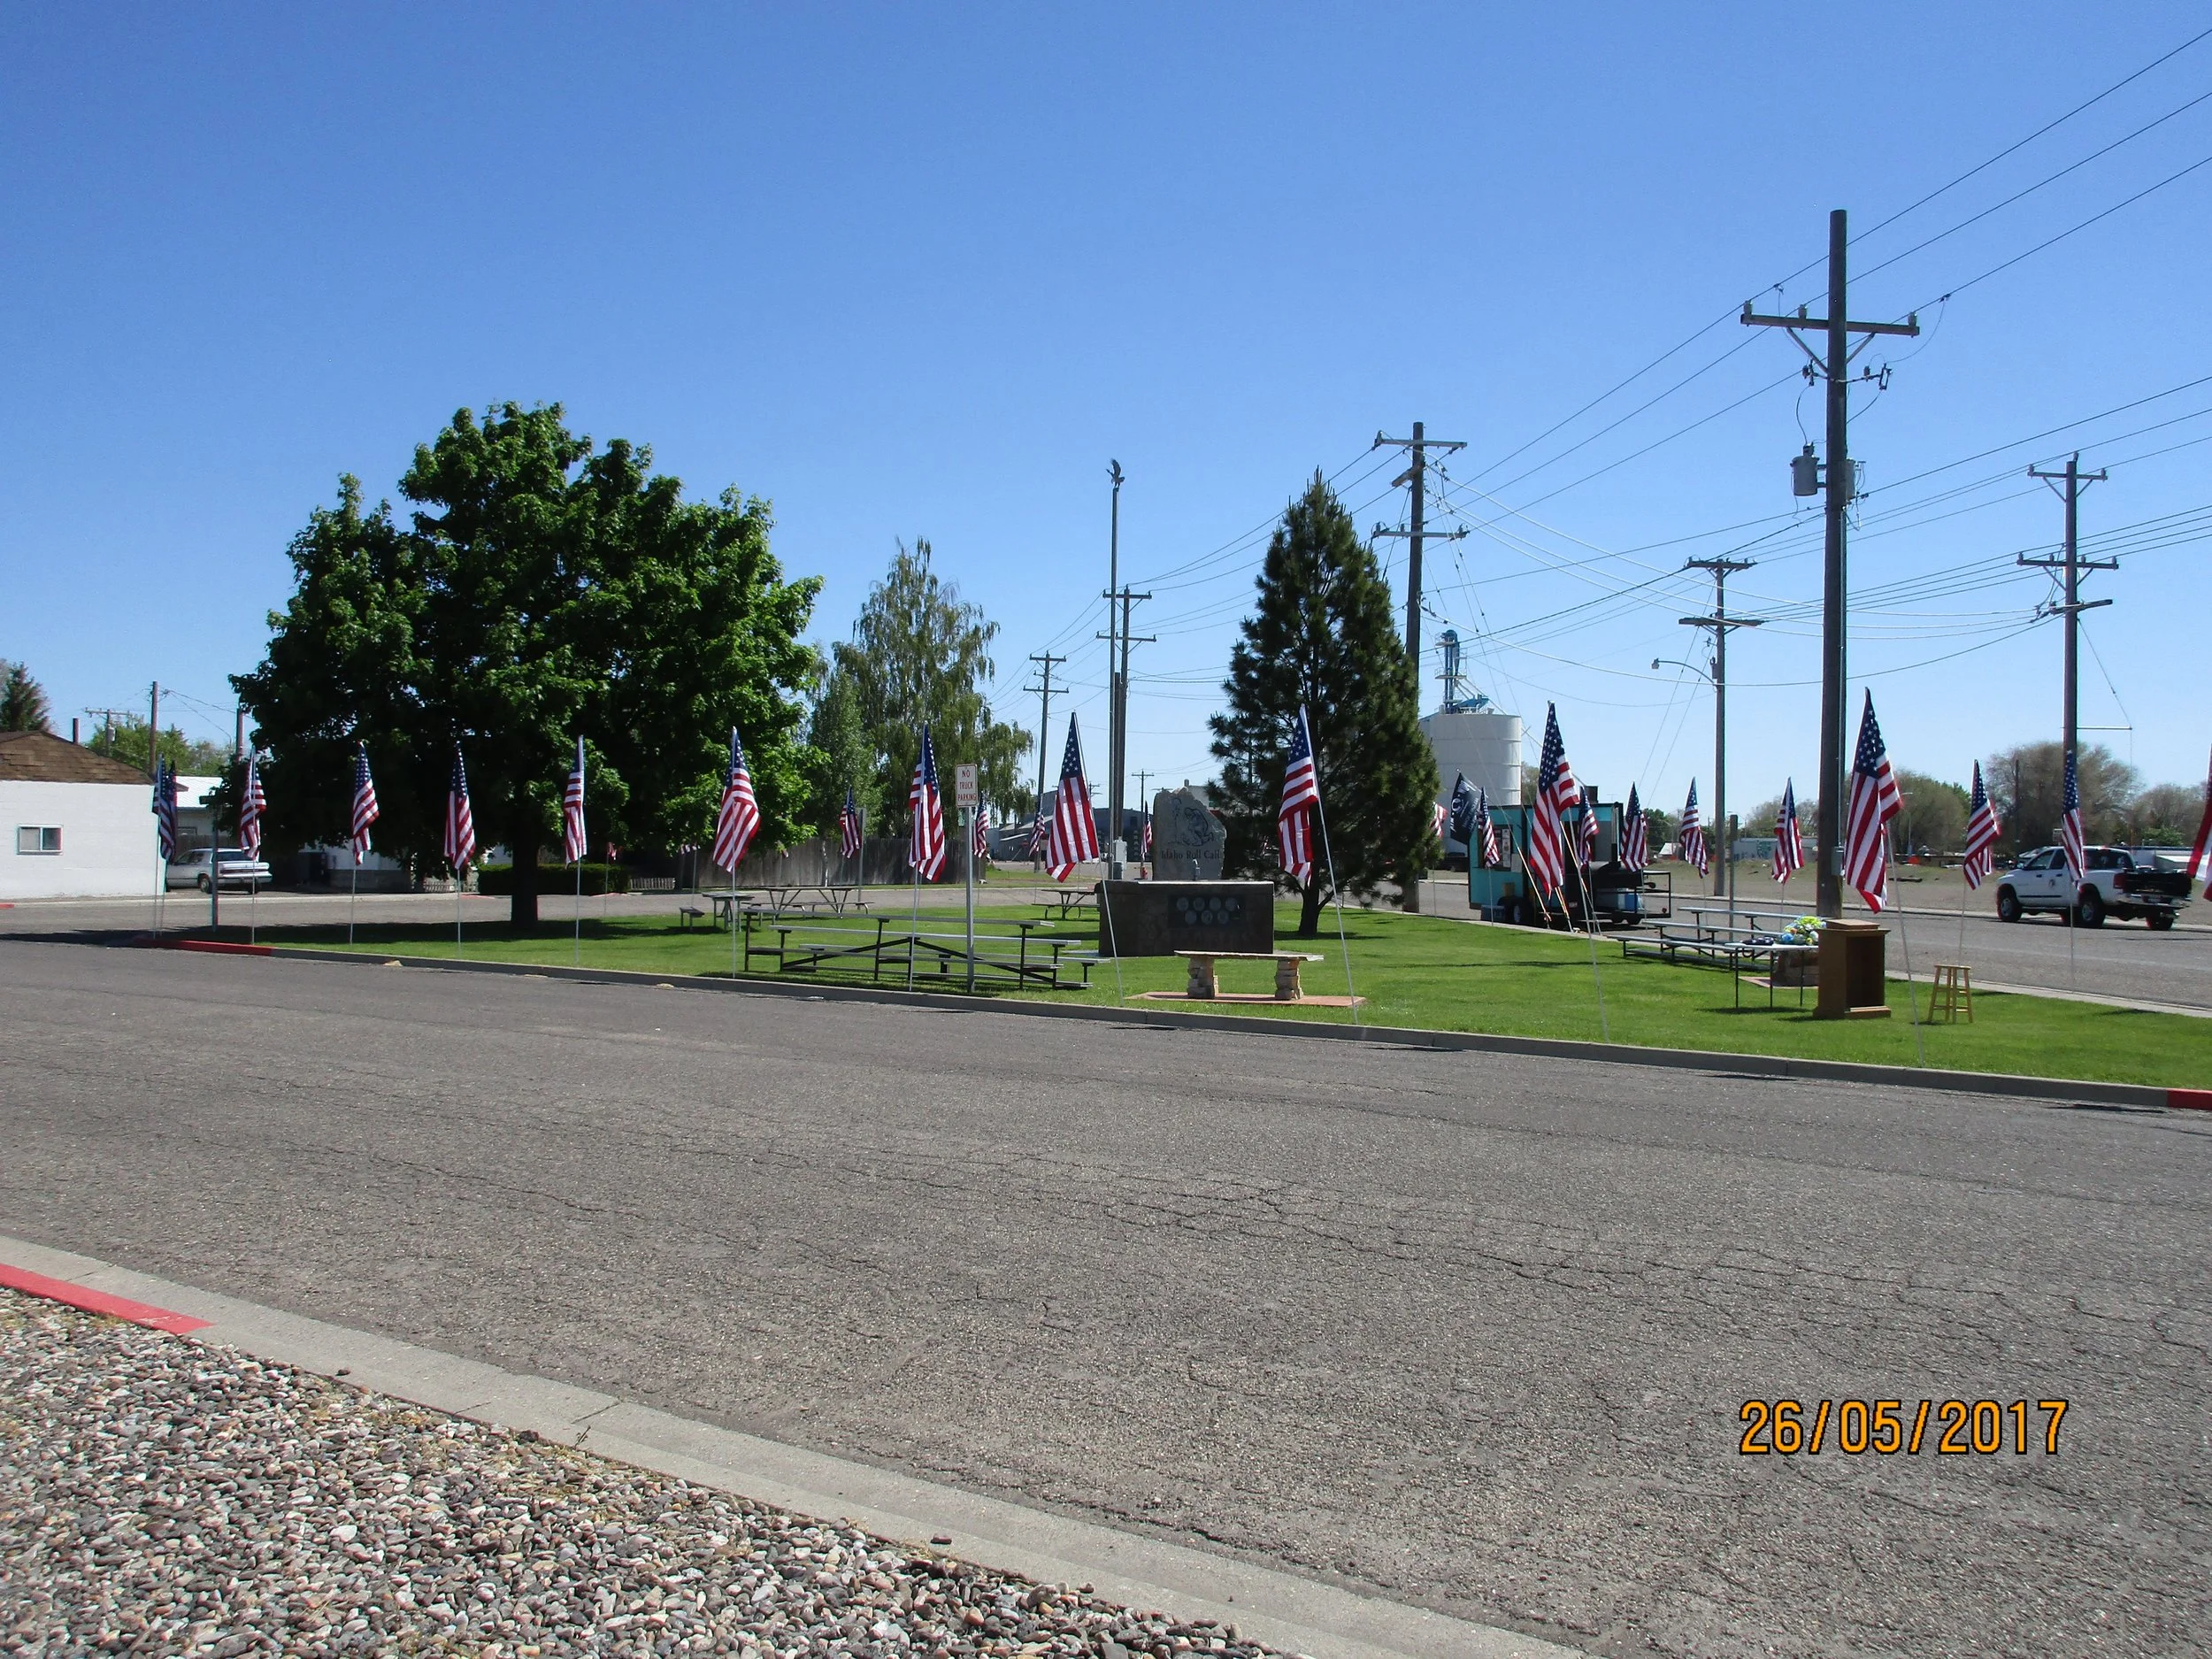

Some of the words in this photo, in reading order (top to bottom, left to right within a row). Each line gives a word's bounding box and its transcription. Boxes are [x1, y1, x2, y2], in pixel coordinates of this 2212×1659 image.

[959, 781, 973, 790] TRUCK
[1161, 849, 1183, 859] Idaho
[1187, 849, 1202, 859] Roll
[1203, 849, 1220, 859] Call
